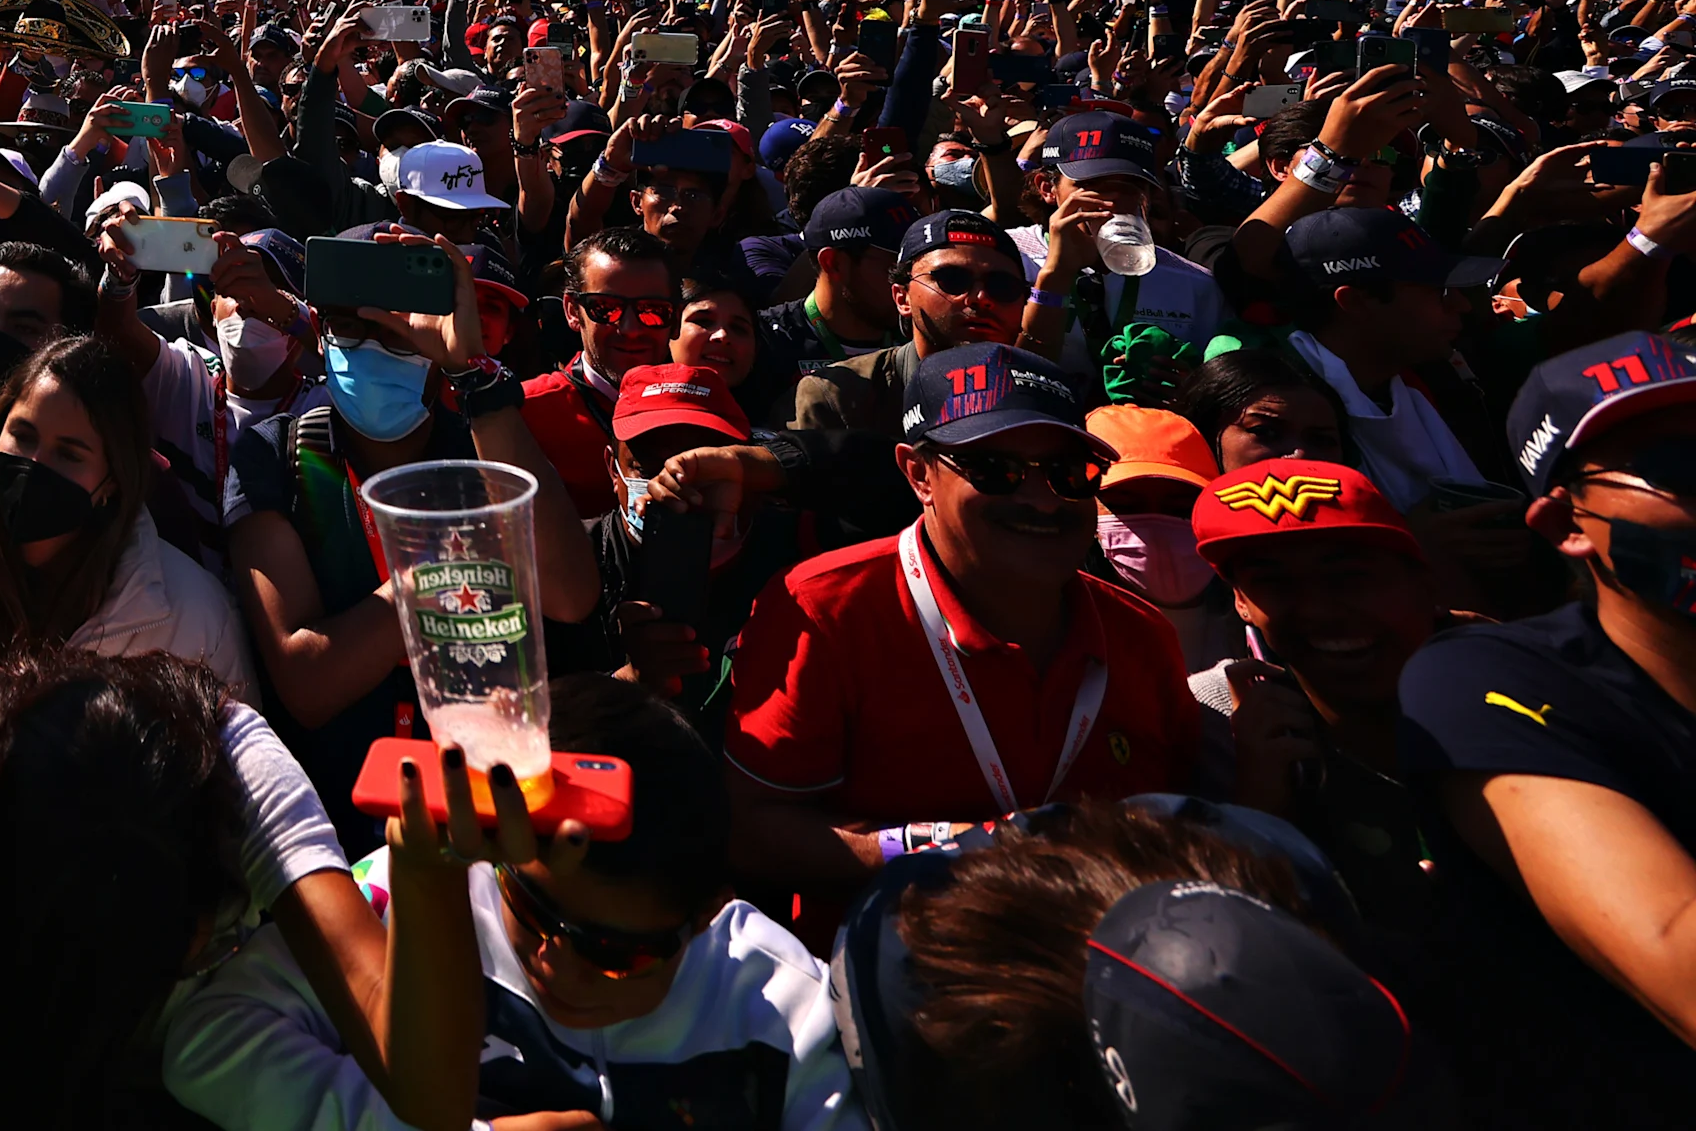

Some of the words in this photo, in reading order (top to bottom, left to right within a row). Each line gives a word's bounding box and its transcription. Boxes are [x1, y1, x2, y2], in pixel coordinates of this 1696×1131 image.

[1075, 130, 1103, 147] 11
[886, 205, 911, 224] 11
[829, 225, 872, 241] KAVAK
[1396, 225, 1427, 250] 11
[1323, 255, 1381, 275] KAVAK
[945, 364, 988, 396] 11
[1581, 354, 1652, 394] 11
[1518, 413, 1561, 477] KAVAK
[422, 612, 522, 640] Heineken
[938, 637, 965, 689] Santander
